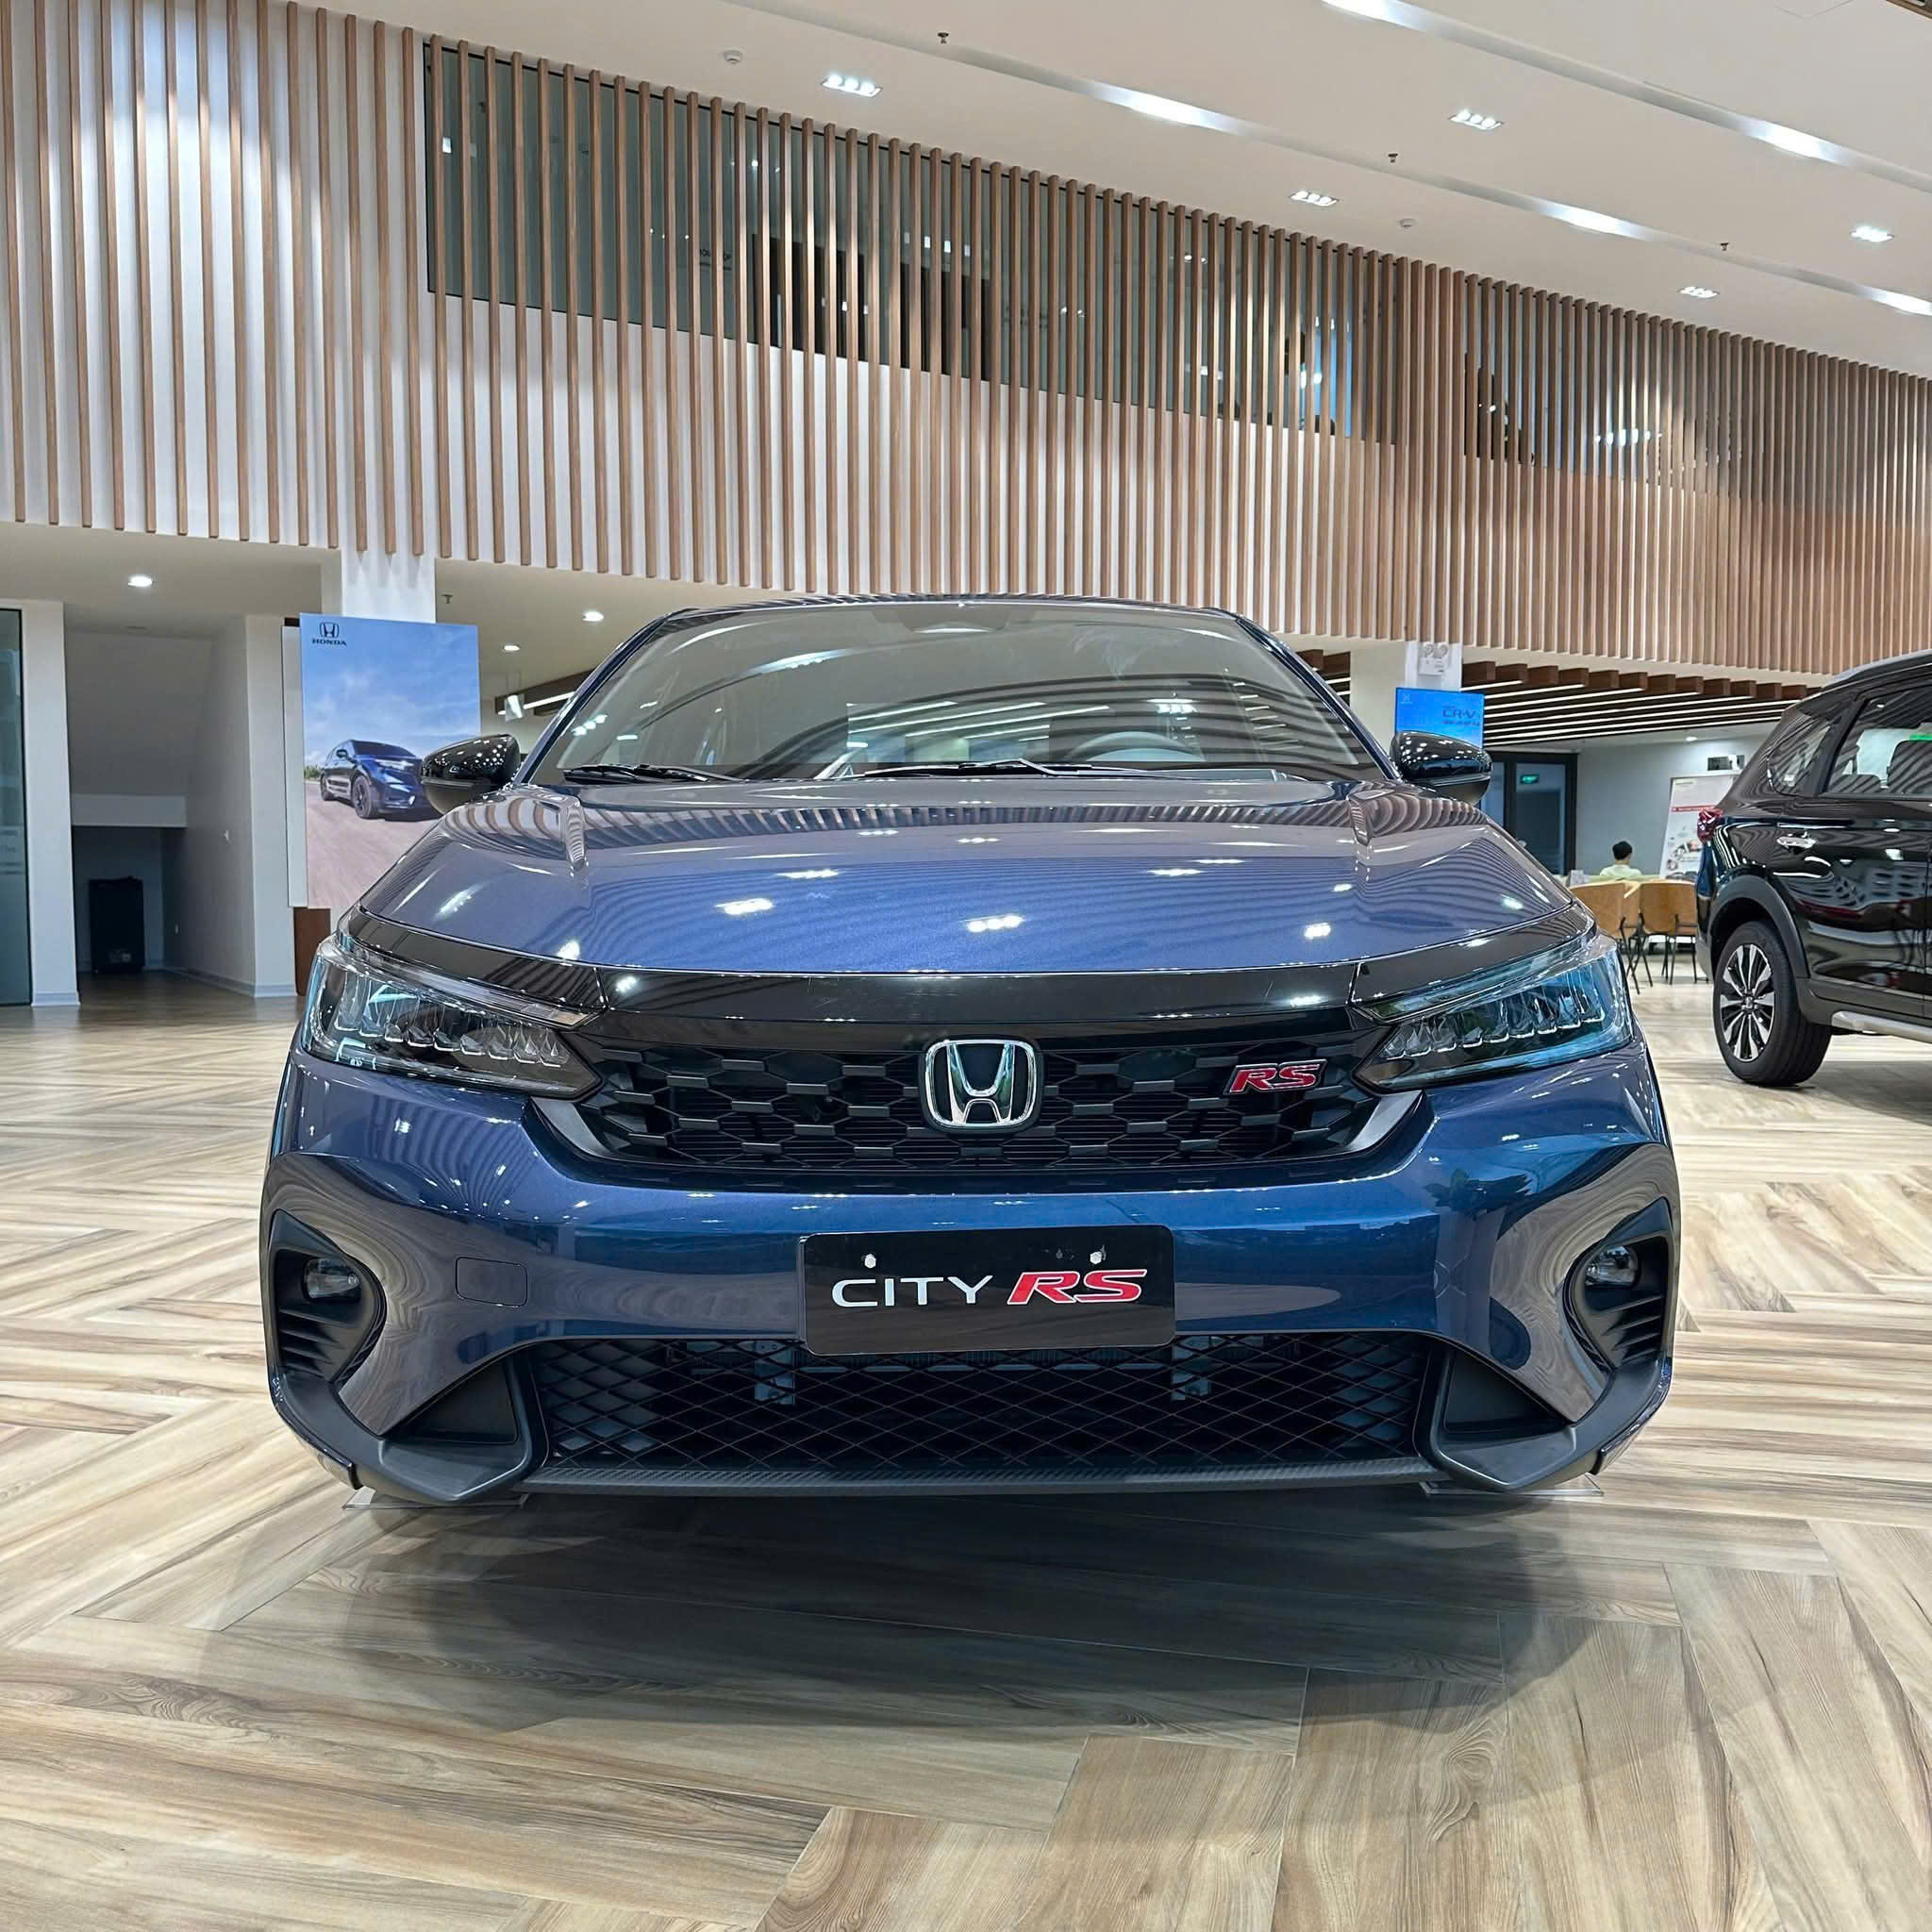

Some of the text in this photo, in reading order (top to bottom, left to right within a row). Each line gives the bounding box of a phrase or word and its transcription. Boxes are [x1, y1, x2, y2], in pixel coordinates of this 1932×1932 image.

[311, 638, 347, 646] HONDA
[1227, 1061, 1324, 1093] RS
[831, 1269, 1147, 1307] CITY RS
